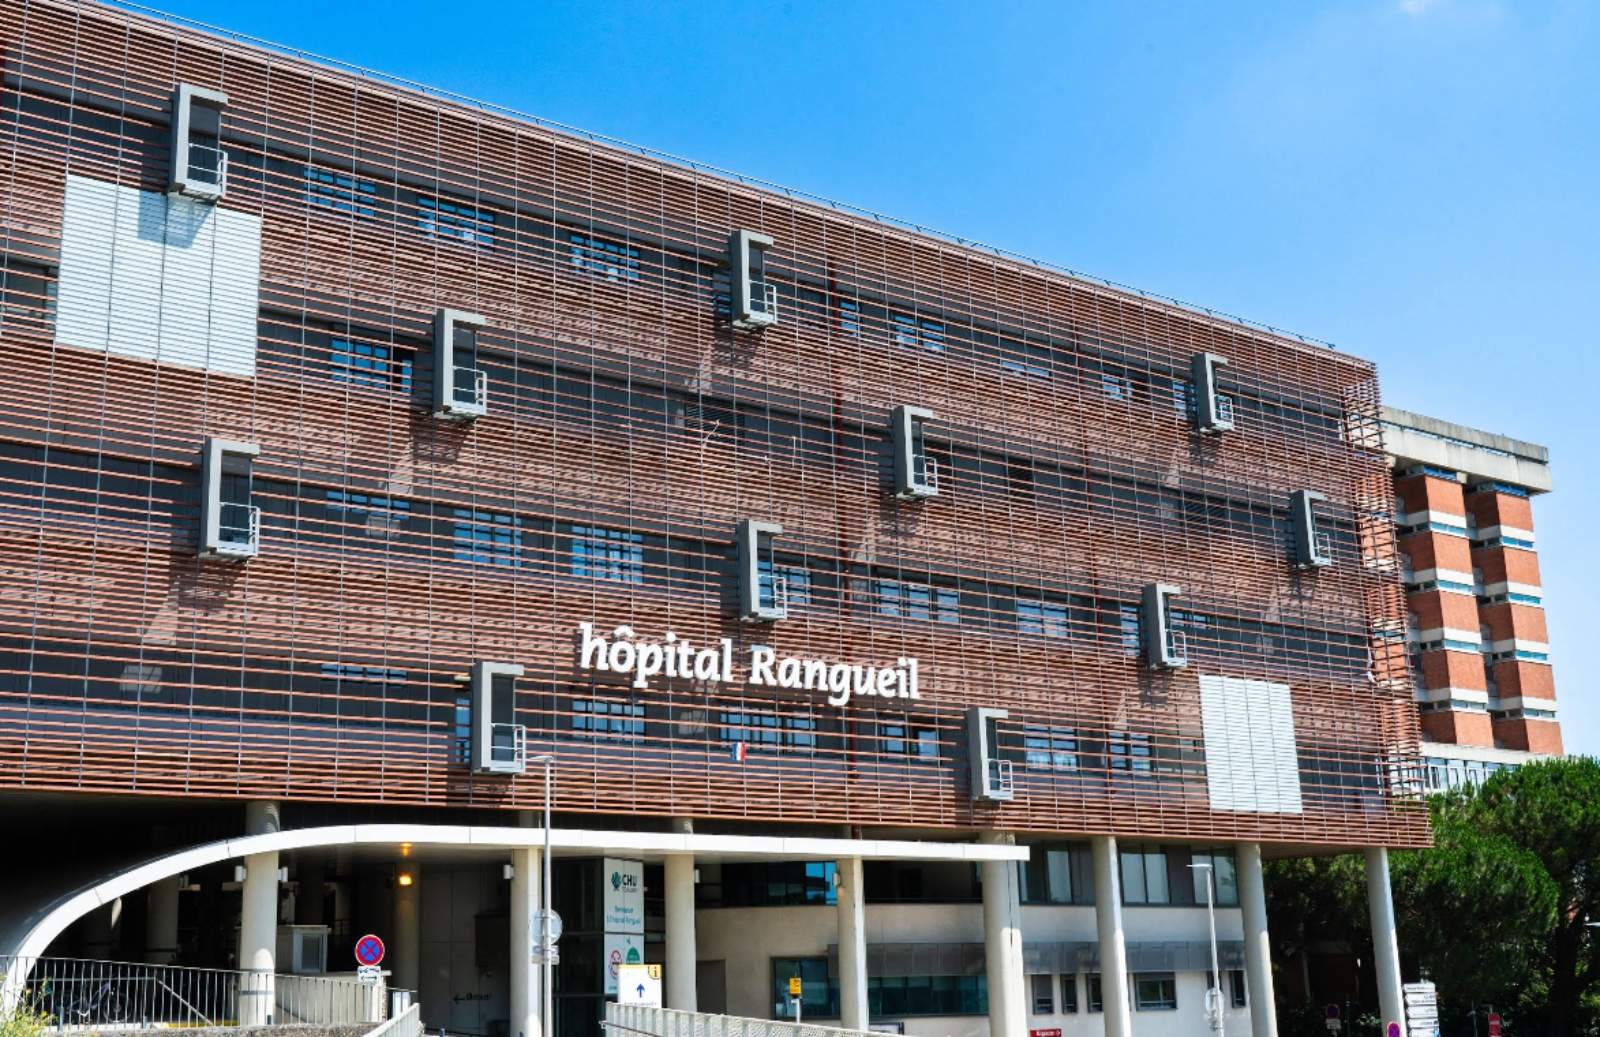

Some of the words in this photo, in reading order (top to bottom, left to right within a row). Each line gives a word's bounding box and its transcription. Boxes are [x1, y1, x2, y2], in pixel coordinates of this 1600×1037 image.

[579, 623, 733, 689] hôpital
[750, 644, 920, 707] Rangueil
[622, 874, 638, 887] CHU
